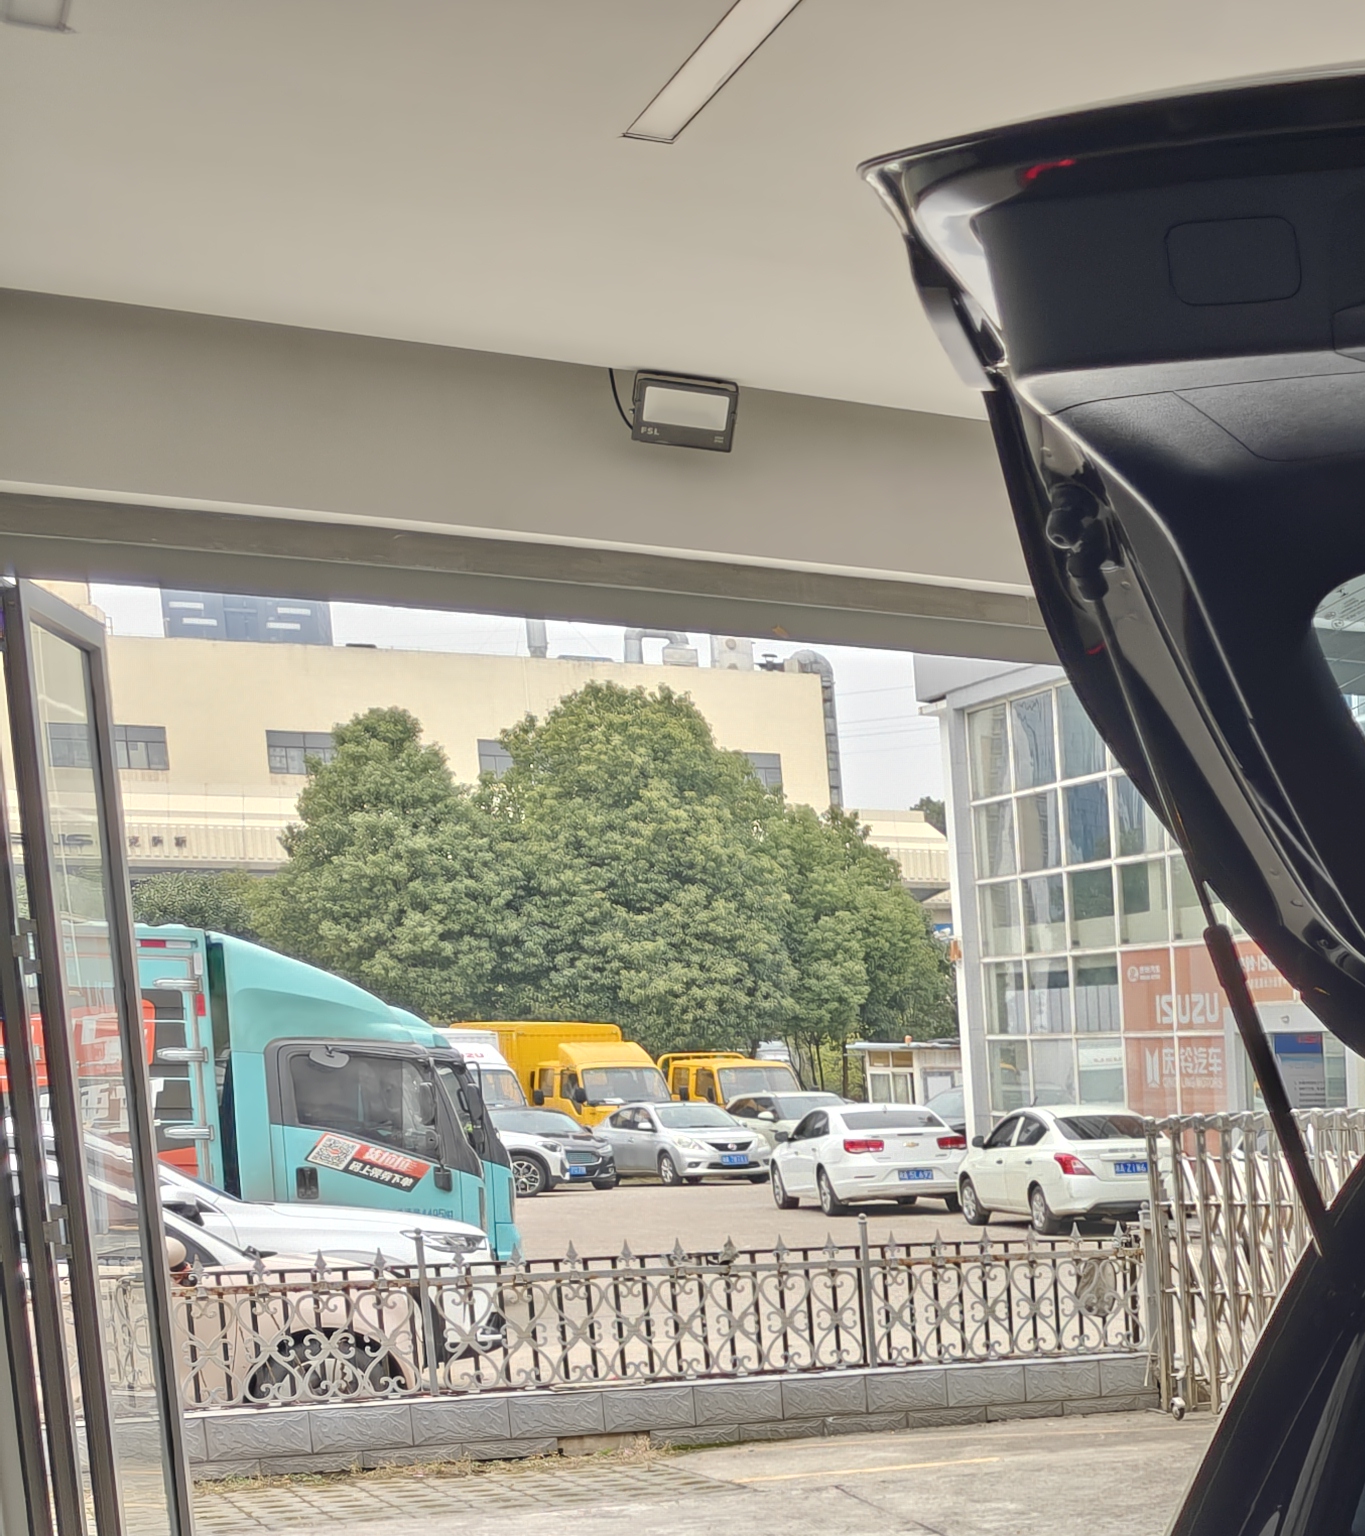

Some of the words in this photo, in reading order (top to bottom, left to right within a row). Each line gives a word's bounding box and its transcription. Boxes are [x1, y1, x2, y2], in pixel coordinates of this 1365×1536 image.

[641, 426, 660, 436] FSL
[1155, 992, 1220, 1025] ISUZU
[1162, 1046, 1222, 1075] 庆铃汽车
